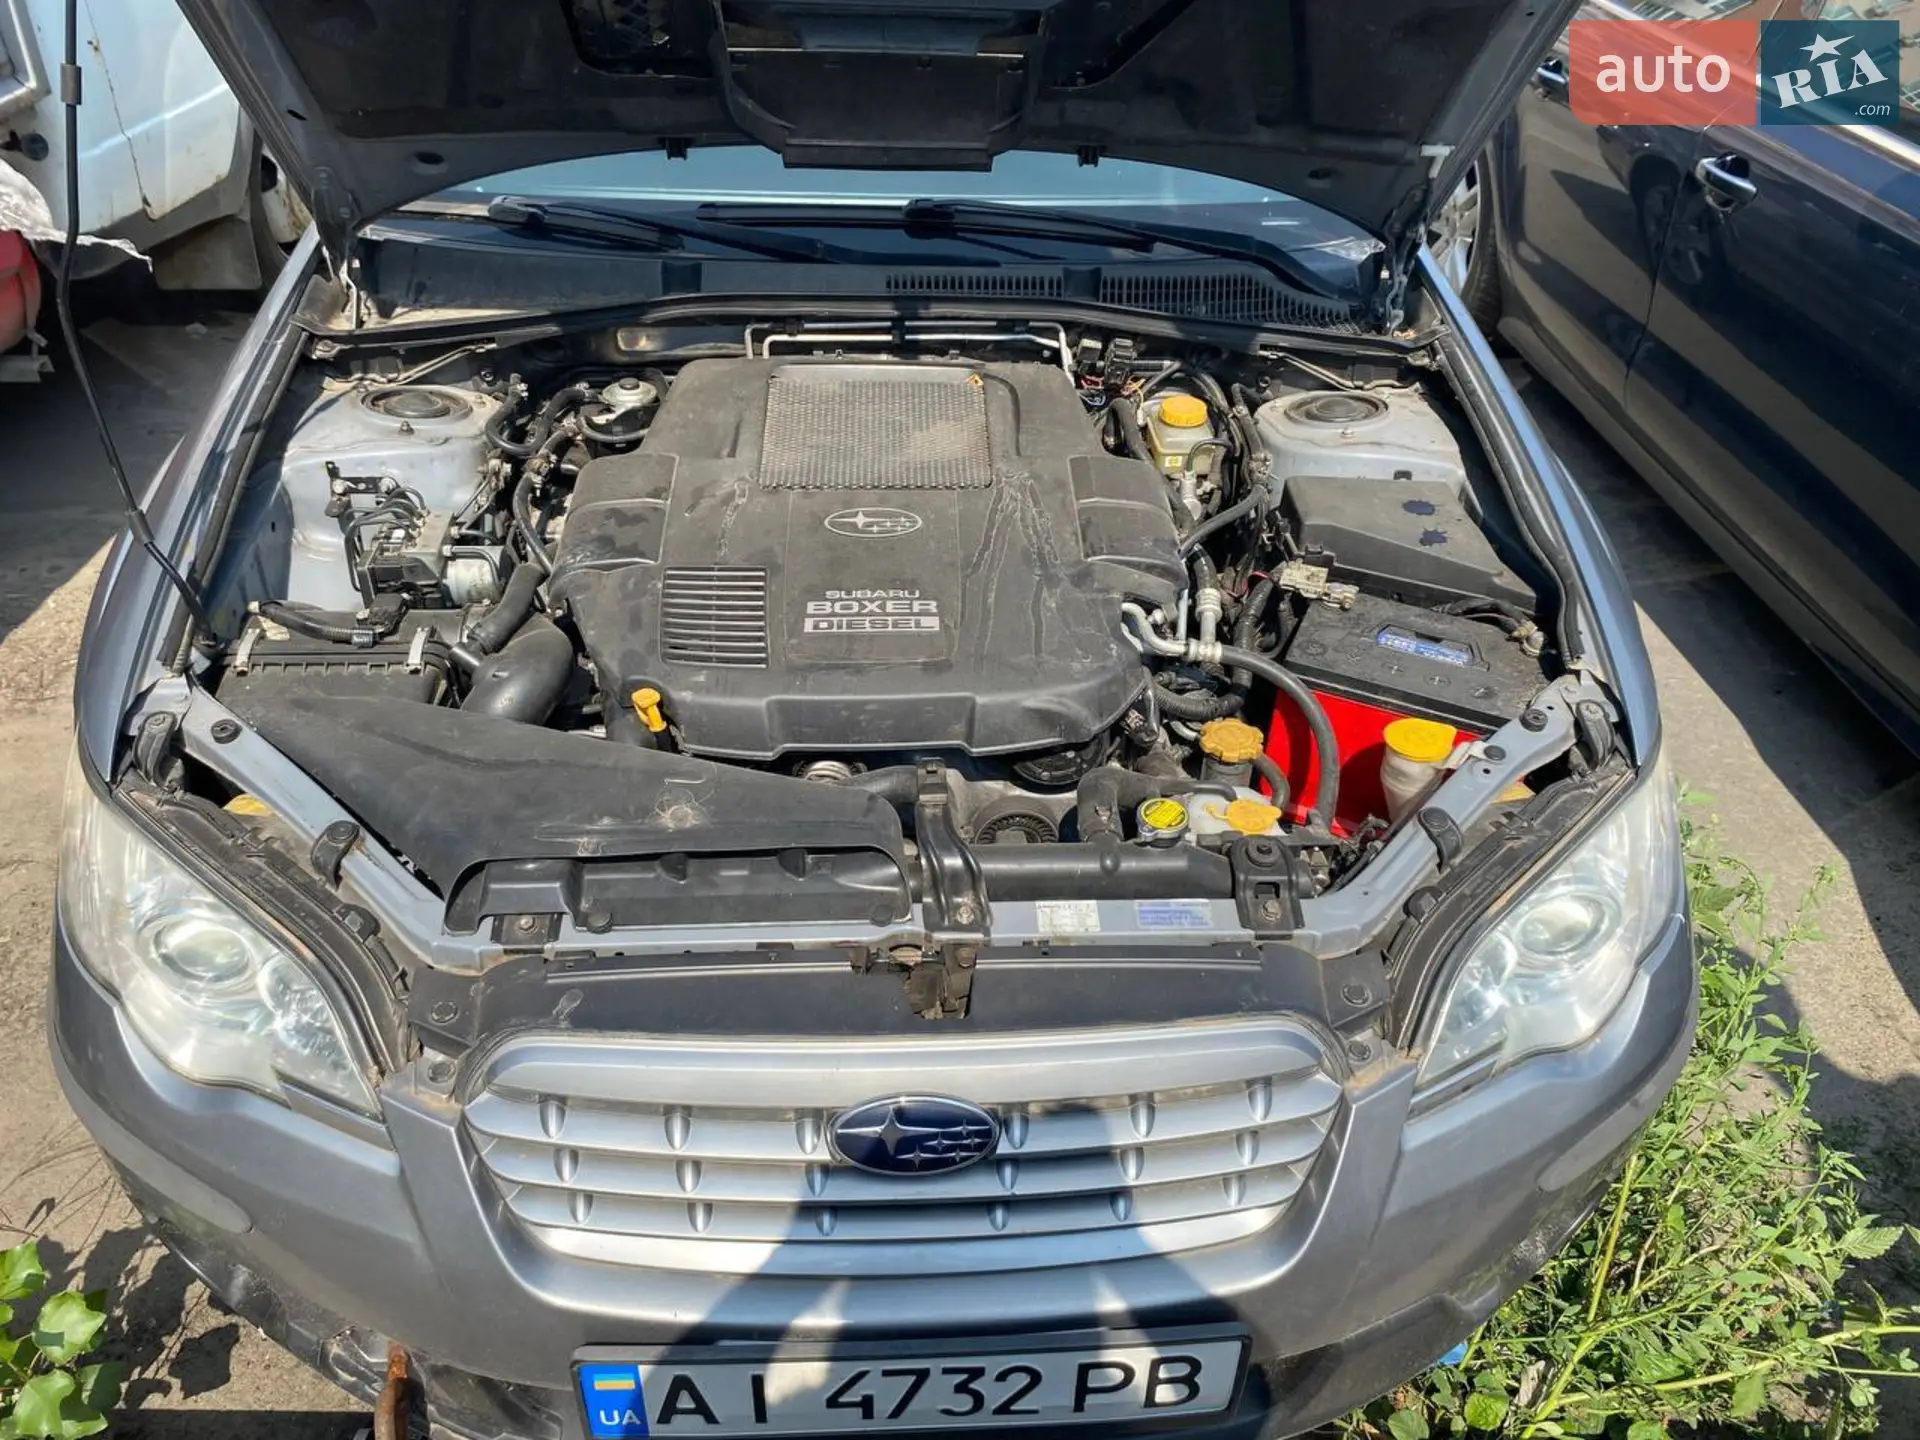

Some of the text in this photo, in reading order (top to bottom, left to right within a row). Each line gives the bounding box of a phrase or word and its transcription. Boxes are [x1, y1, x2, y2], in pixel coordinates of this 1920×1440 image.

[825, 589, 920, 599] SUBARU
[806, 600, 938, 614] BOXER
[811, 618, 935, 631] DIESEL
[824, 1365, 1044, 1421] 4732
[1073, 1355, 1203, 1414] PB
[600, 1409, 641, 1427] UA
